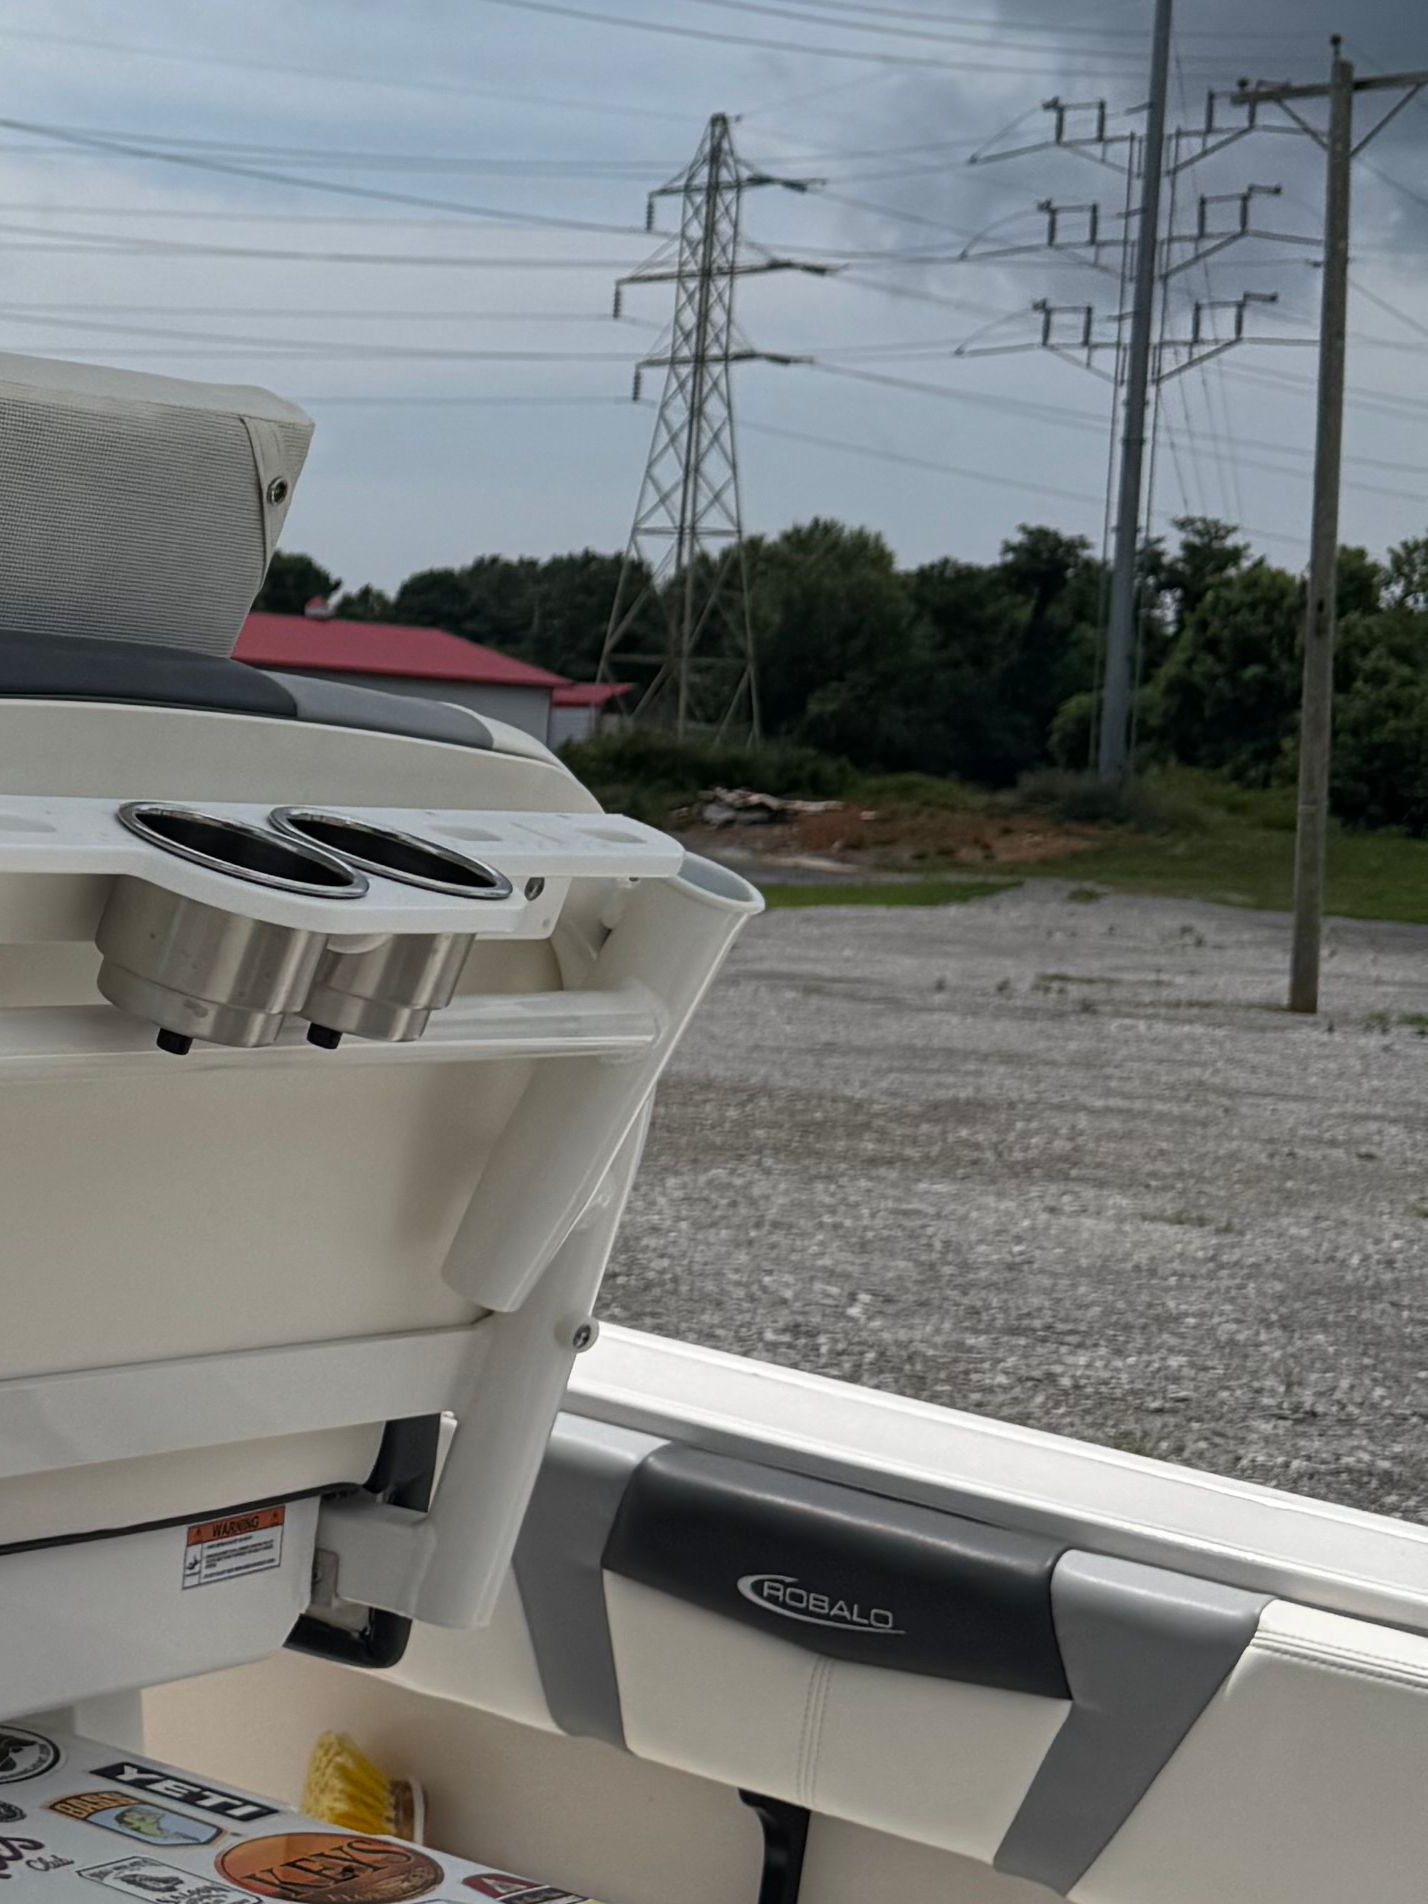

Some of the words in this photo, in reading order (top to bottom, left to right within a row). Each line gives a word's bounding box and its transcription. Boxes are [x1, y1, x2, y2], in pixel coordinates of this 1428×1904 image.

[212, 1515, 260, 1537] WARNING
[760, 1579, 896, 1630] ROBALO
[114, 1764, 260, 1817] YETI
[25, 1854, 75, 1872] Club
[243, 1839, 412, 1896] KEYS
